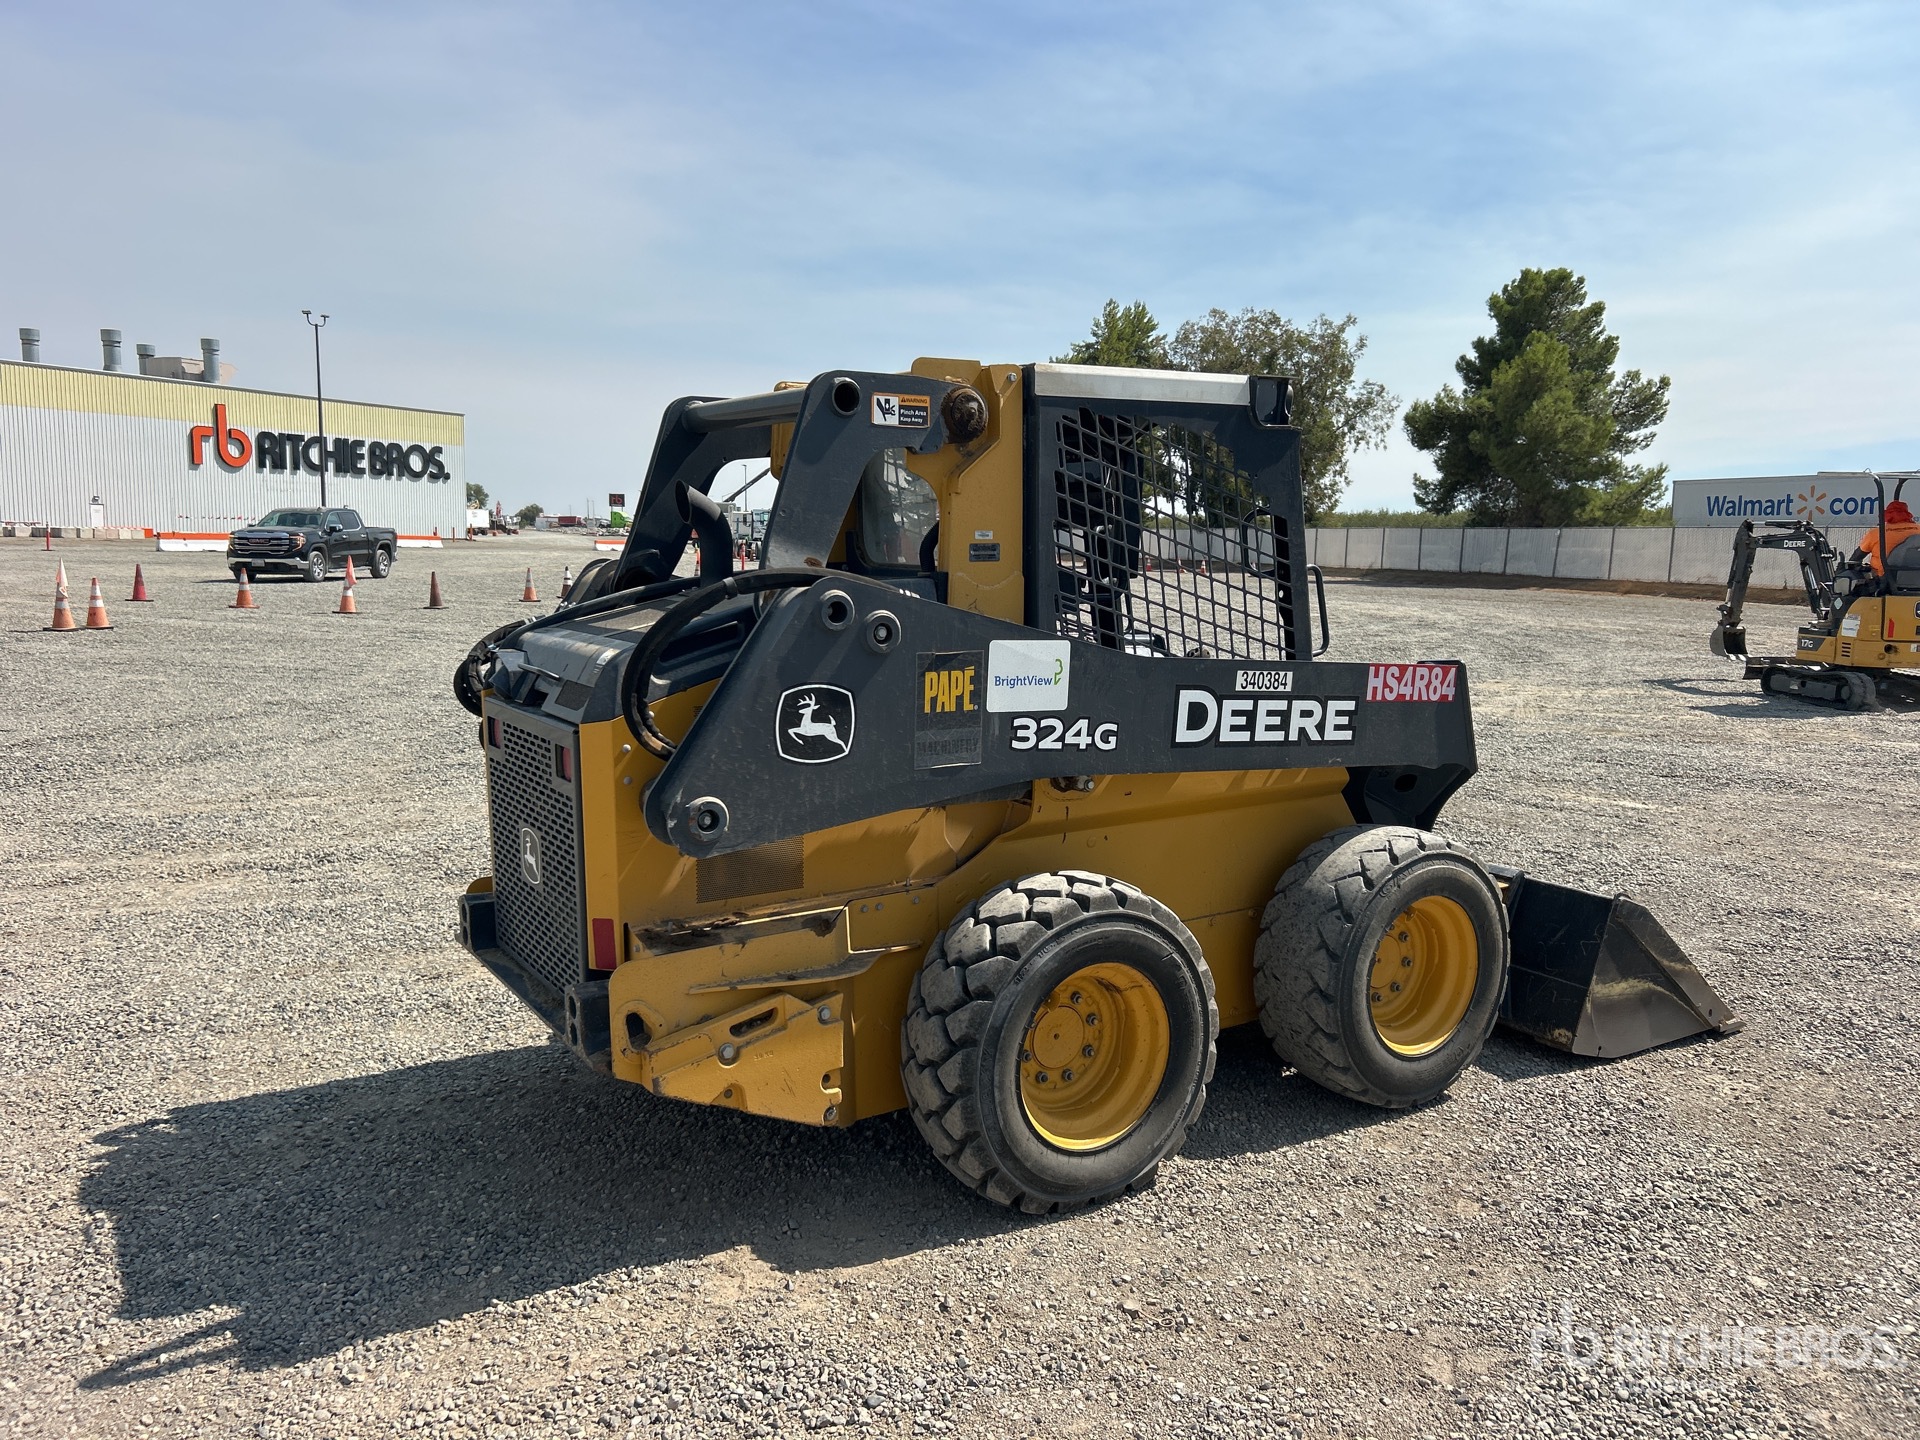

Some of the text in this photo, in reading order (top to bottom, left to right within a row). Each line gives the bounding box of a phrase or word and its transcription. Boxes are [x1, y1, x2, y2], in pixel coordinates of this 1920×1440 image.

[190, 403, 252, 467] rb
[257, 431, 450, 480] RITCHIE BROS.
[1706, 493, 1880, 517] Walmart com
[1783, 540, 1807, 548] DEERE
[1801, 639, 1814, 648] 17G
[994, 675, 1053, 689] BrightView
[1240, 671, 1288, 690] 340384
[1366, 666, 1457, 702] HS4R84
[1175, 690, 1356, 742] DEERE
[1011, 717, 1118, 750] 324G
